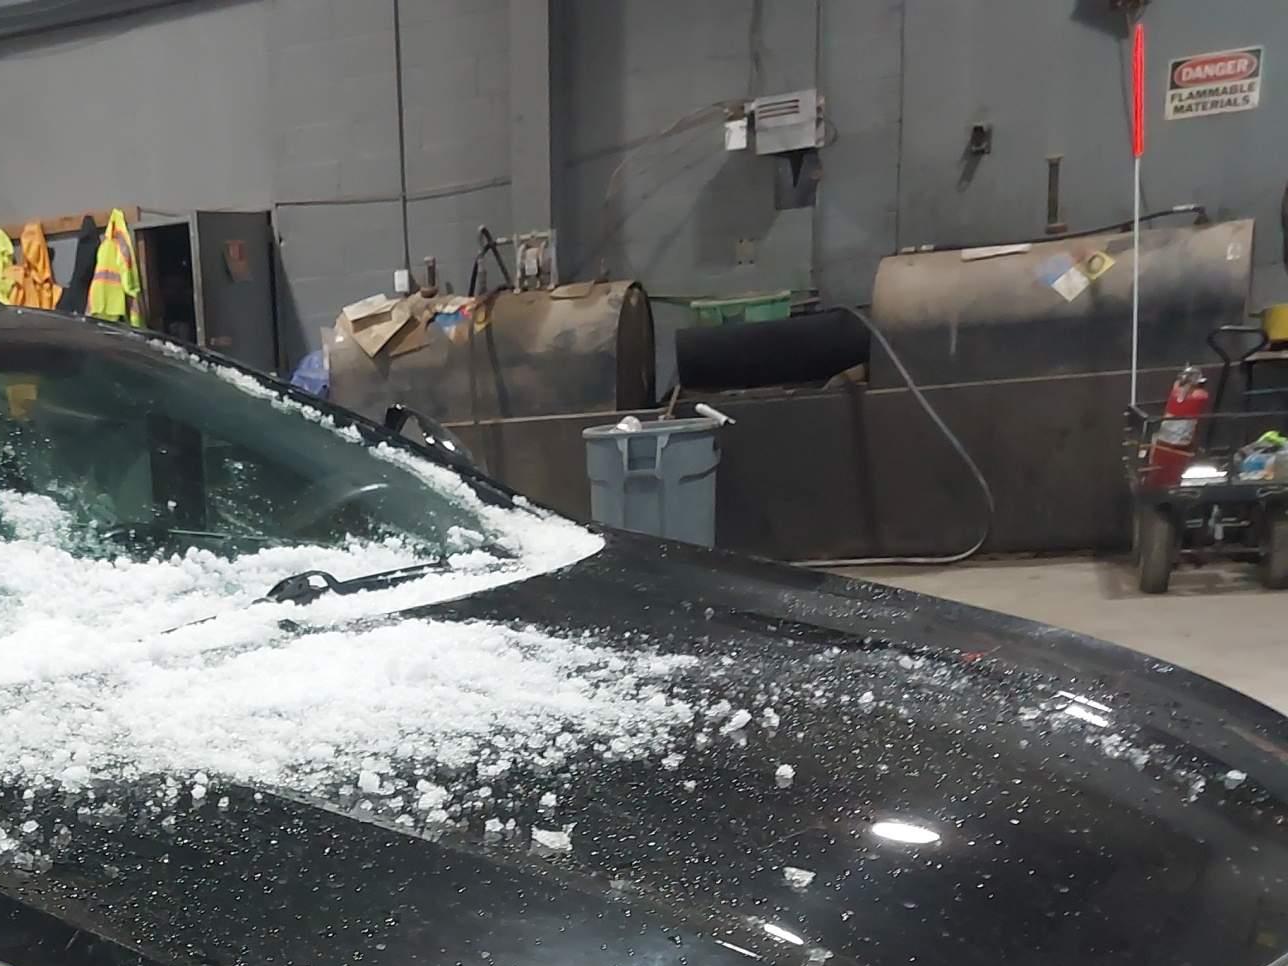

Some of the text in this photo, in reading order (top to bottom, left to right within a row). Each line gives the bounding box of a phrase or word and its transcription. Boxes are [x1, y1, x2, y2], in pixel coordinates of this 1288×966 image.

[1181, 58, 1249, 81] DANGER
[1170, 81, 1256, 104] FLAMMABLE
[1173, 95, 1250, 115] MATERIALS
